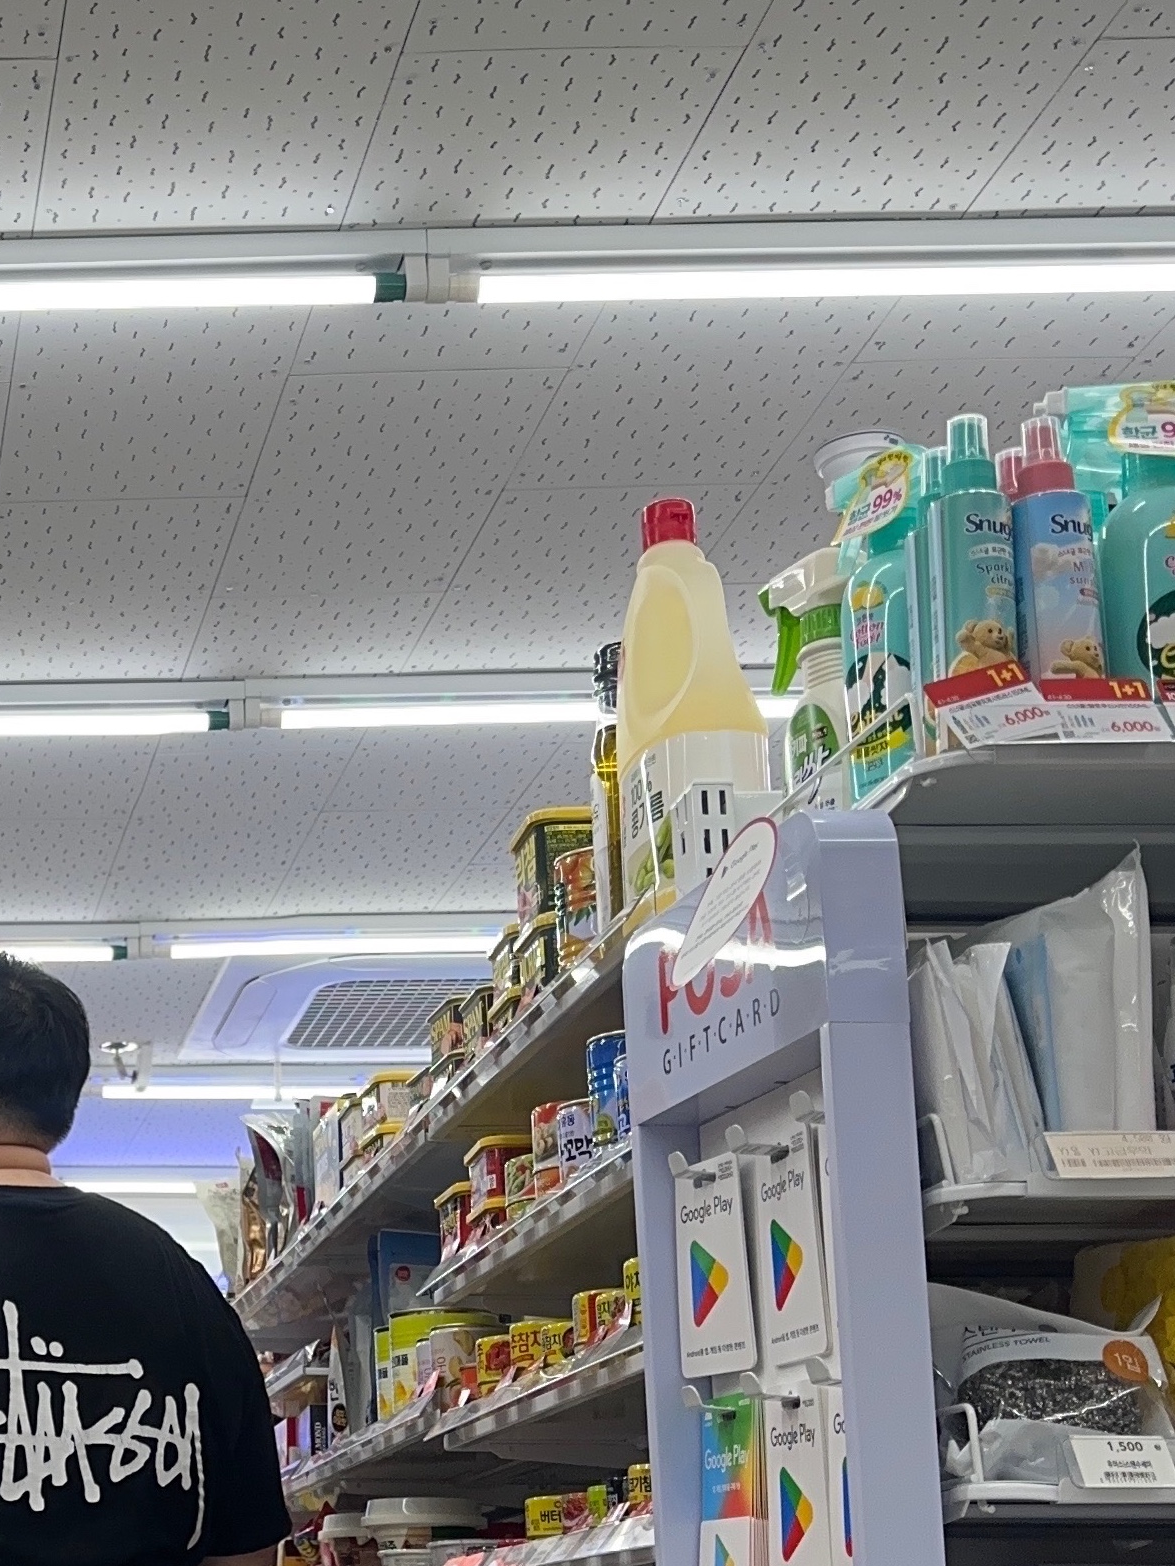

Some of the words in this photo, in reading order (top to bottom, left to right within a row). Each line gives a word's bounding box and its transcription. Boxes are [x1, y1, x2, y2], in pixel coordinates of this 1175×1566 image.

[987, 663, 1025, 687] 1+1
[1109, 681, 1146, 698] 1+1
[1004, 706, 1044, 726] 6,000
[1110, 721, 1154, 733] 6,000
[761, 1179, 787, 1203] Google
[787, 1168, 805, 1191] Play
[679, 1203, 712, 1225] Google
[713, 1194, 734, 1216] Play
[962, 1339, 1011, 1361] STAINLESS
[1013, 1336, 1051, 1346] TOWEL
[770, 1426, 799, 1450] Google
[799, 1422, 816, 1448] Play
[1107, 1441, 1143, 1453] 1,500
[704, 1447, 733, 1473] Google
[732, 1443, 750, 1469] Play
[539, 1509, 562, 1524] 버터
